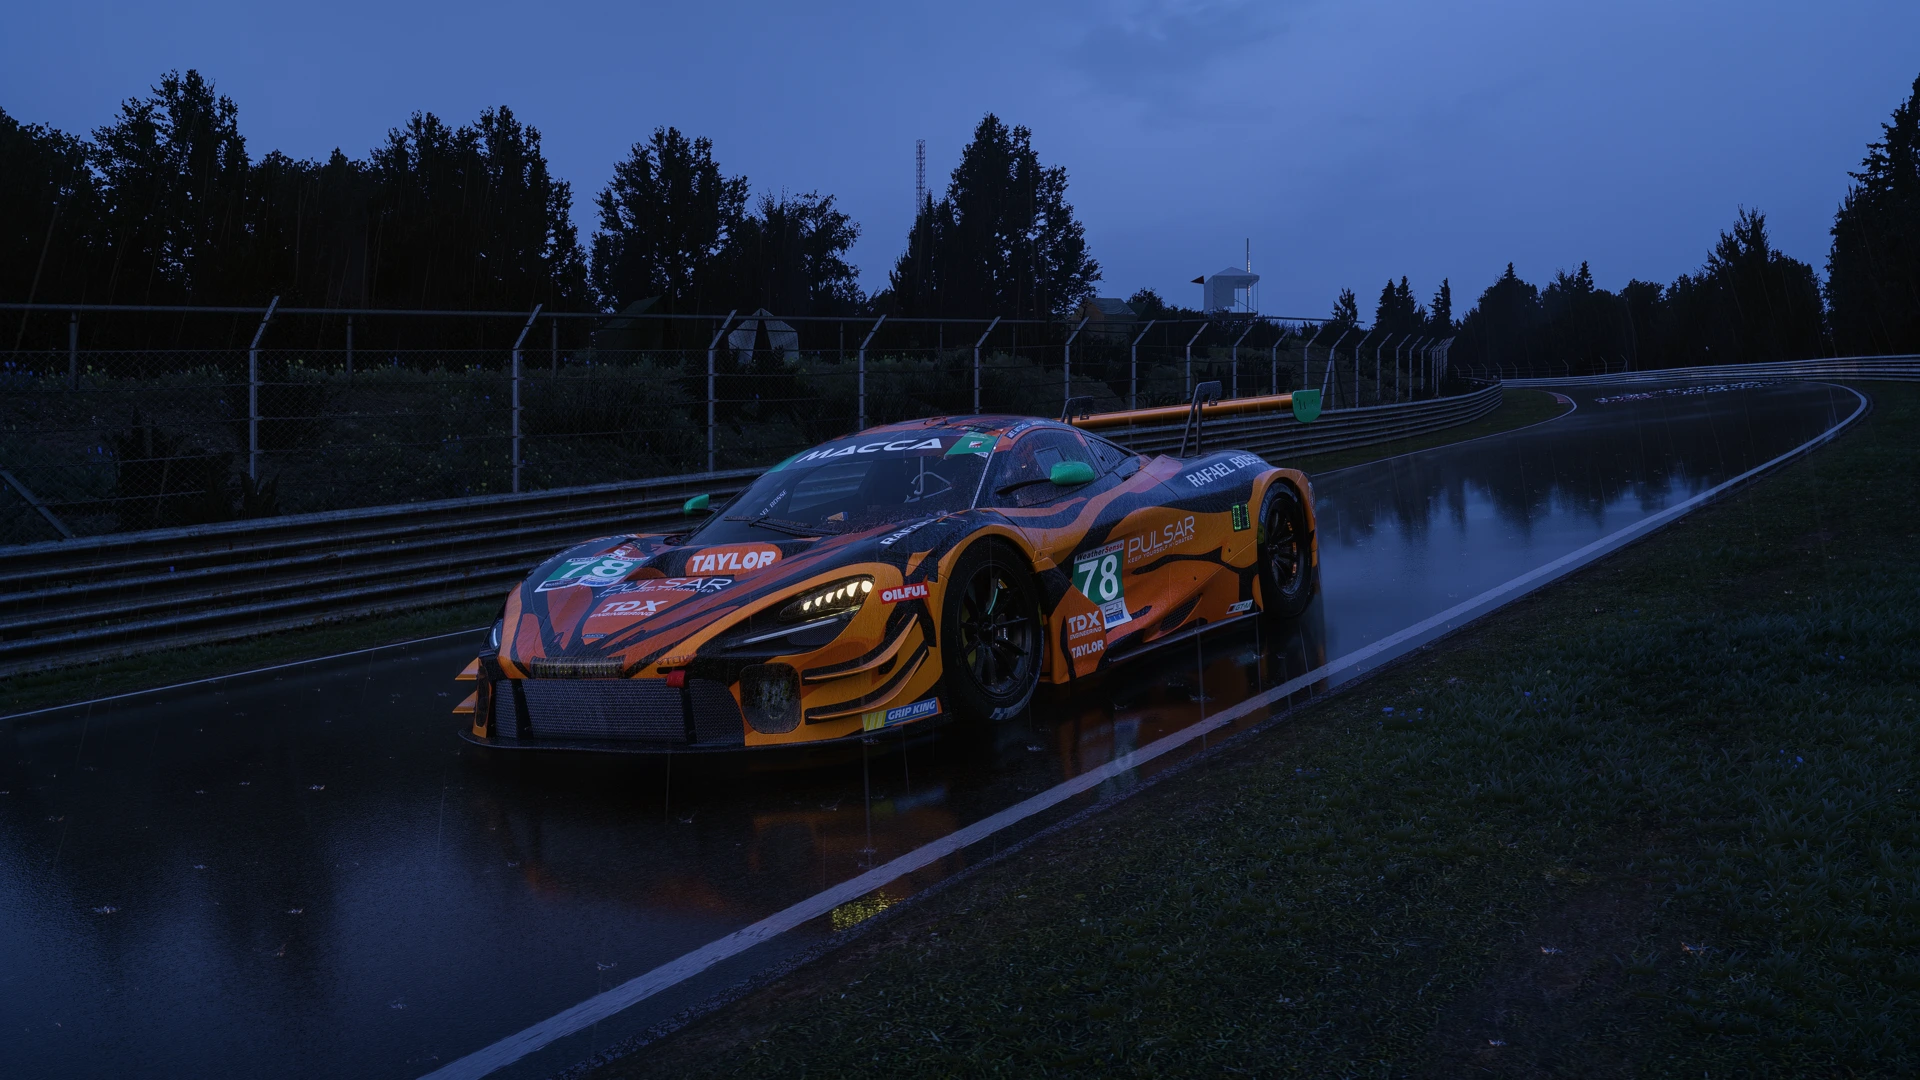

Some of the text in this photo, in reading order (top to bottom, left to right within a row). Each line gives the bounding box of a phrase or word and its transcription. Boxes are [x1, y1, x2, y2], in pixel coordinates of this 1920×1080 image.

[795, 438, 942, 464] MACCA
[1185, 462, 1236, 488] RAFAEL
[1128, 515, 1195, 558] PULSAR
[1076, 541, 1123, 561] WeatherSense
[560, 559, 634, 579] 78
[692, 550, 777, 573] TAYLOR
[600, 577, 733, 596] PULSAR
[1078, 554, 1119, 601] 78
[881, 584, 928, 602] OILFUL
[602, 600, 669, 613] TDX
[1068, 610, 1102, 633] TDX
[1070, 626, 1103, 641] ENGINEERING
[1071, 639, 1104, 659] TAYLOR
[888, 700, 936, 720] GRIP KING
